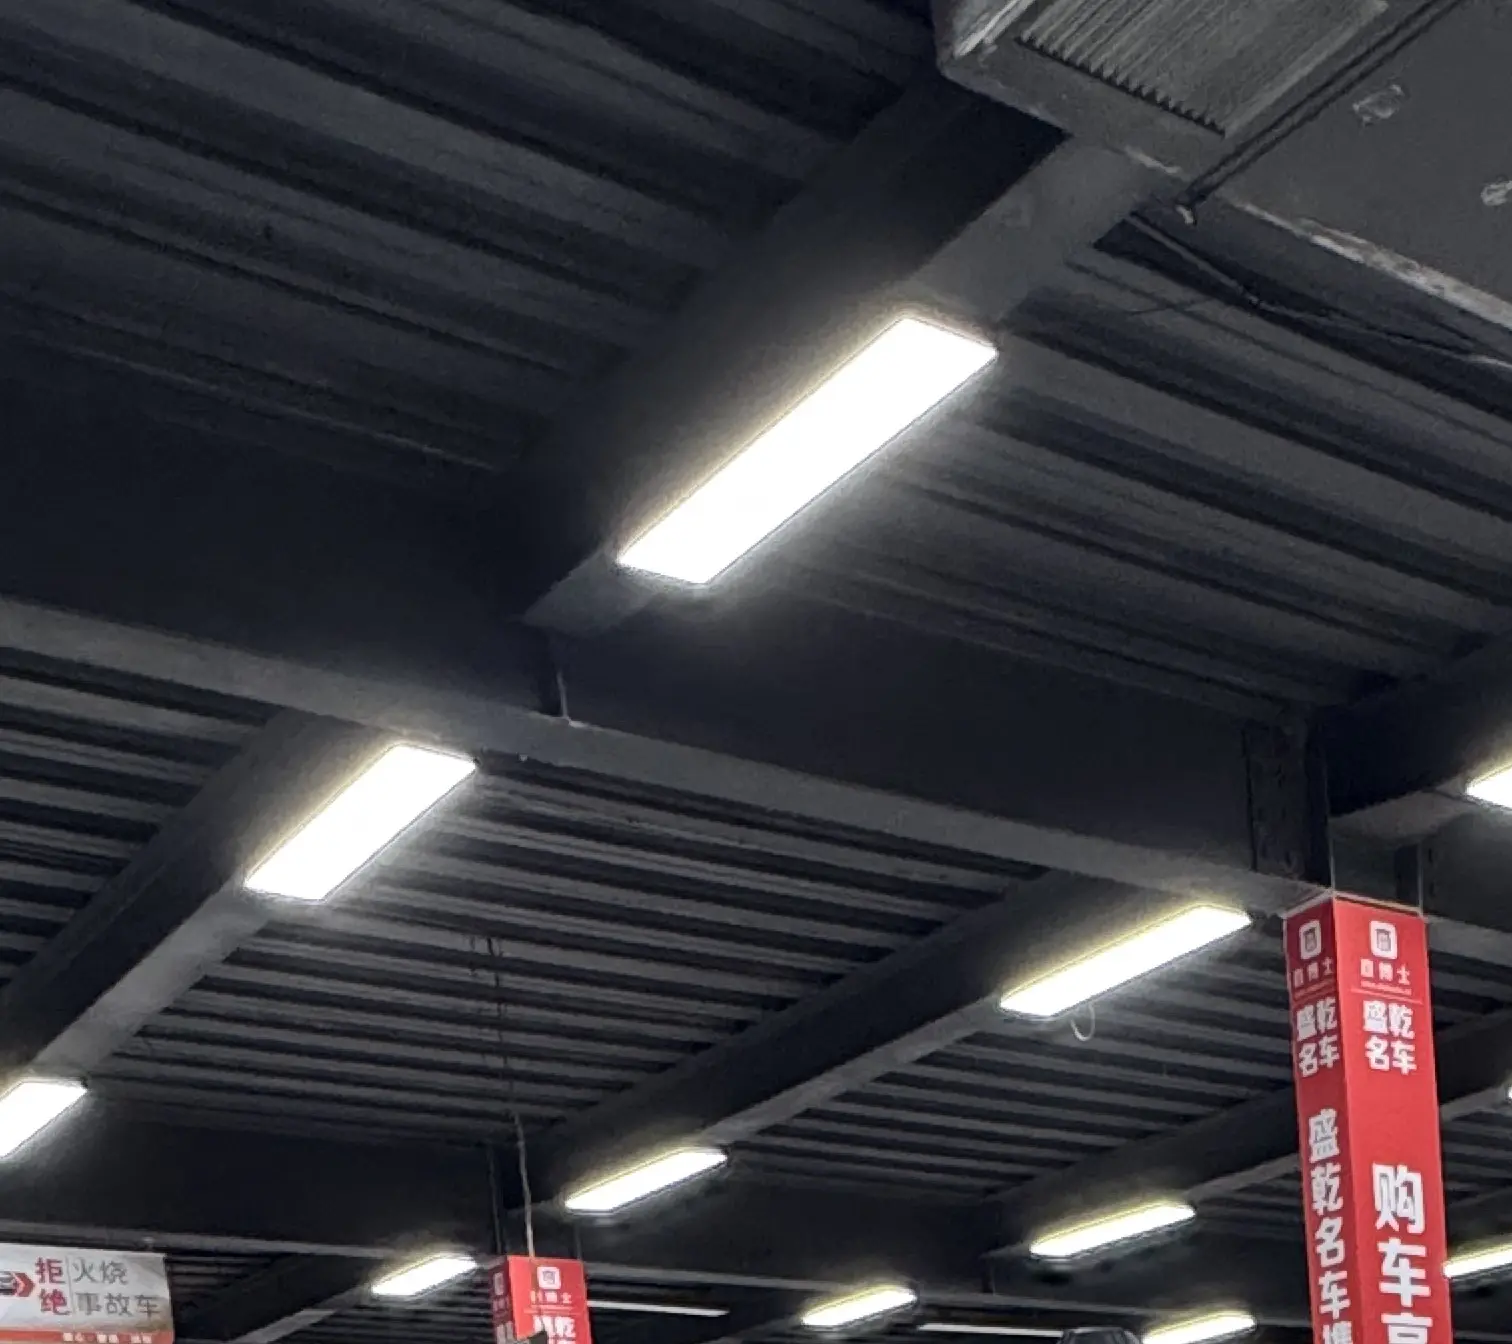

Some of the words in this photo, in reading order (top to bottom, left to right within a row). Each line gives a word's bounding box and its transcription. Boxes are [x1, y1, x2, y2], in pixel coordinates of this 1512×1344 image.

[73, 1256, 129, 1286] 火烧
[35, 1256, 71, 1317] 拒绝
[74, 1291, 162, 1318] 事故车
